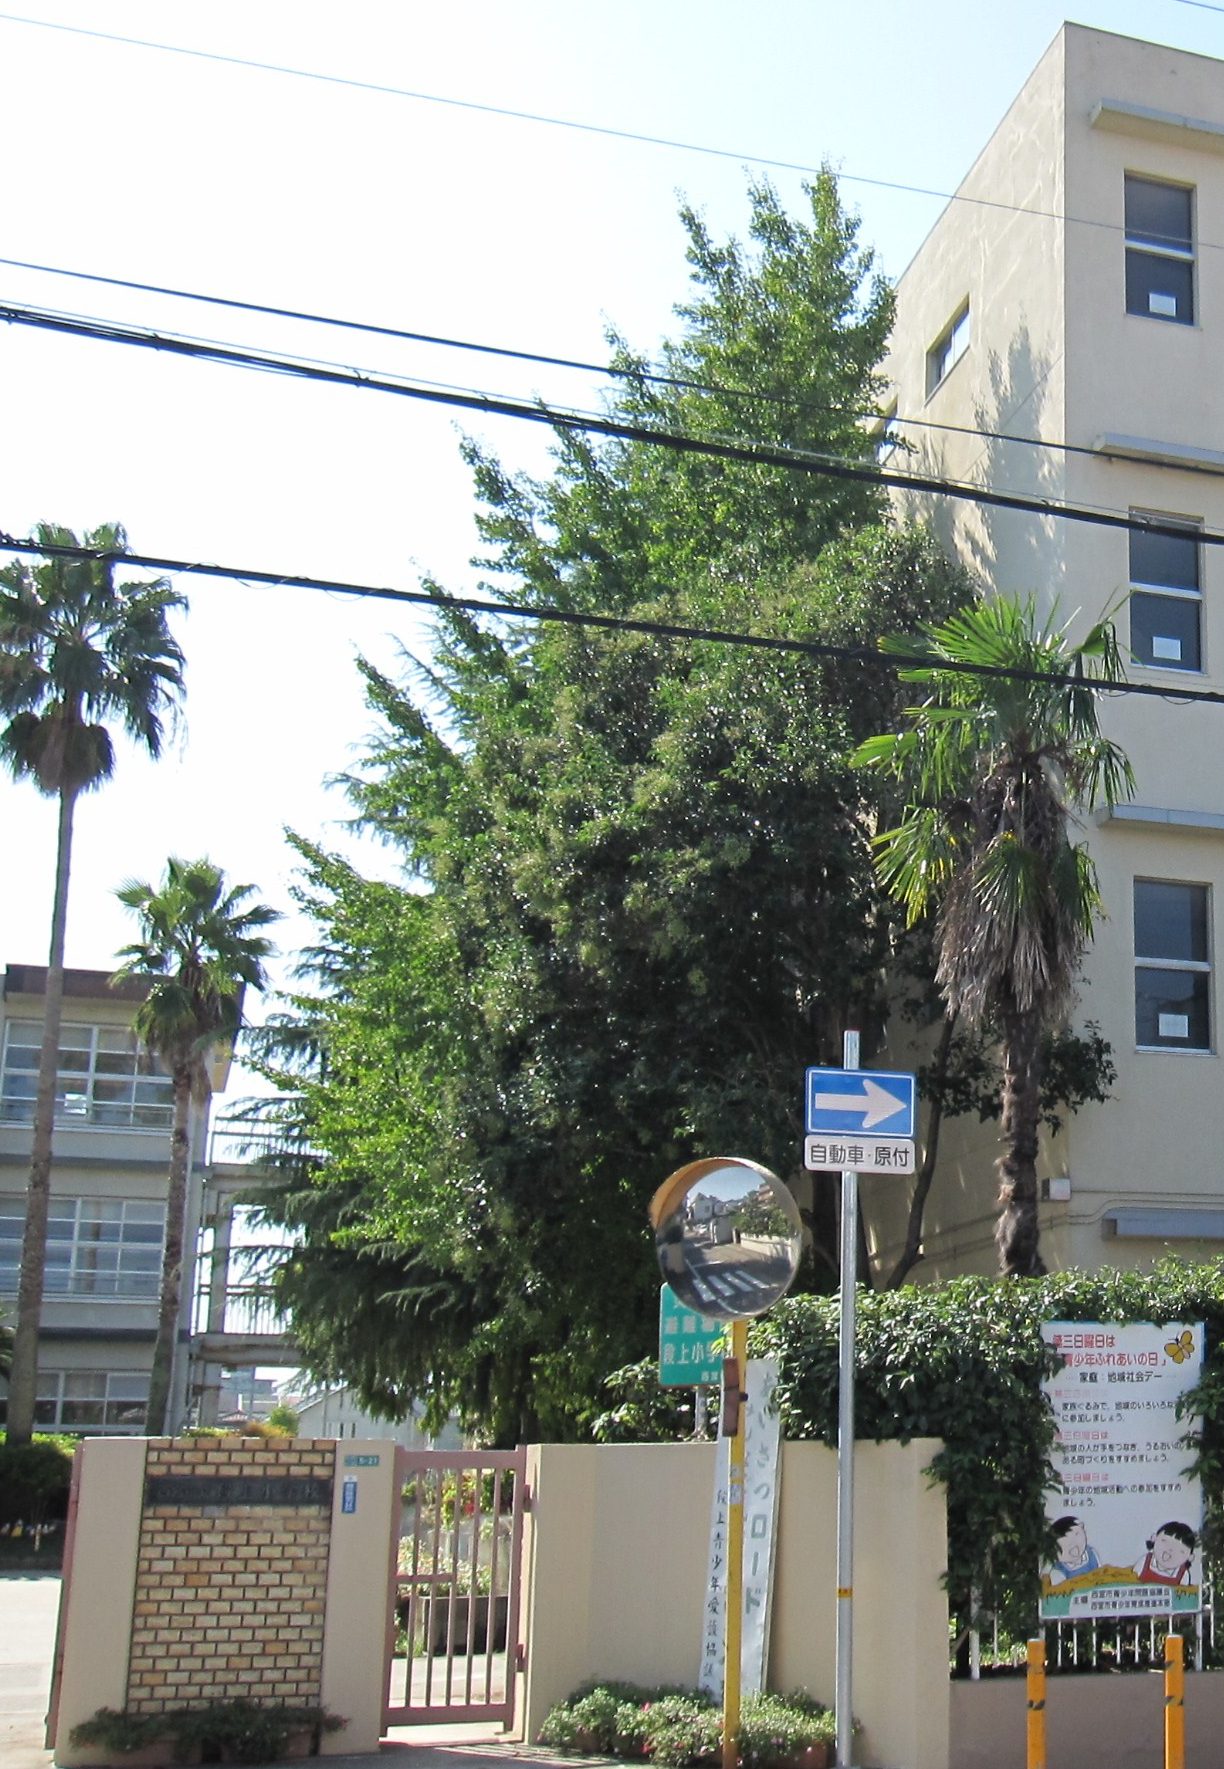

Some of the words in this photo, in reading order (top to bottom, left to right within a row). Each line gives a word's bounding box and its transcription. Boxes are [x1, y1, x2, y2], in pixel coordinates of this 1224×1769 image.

[811, 1144, 910, 1167] 自動車・原付
[1063, 1352, 1166, 1367] 青少年ふれあいの日」
[1063, 1473, 1109, 1482] 三日曜日は
